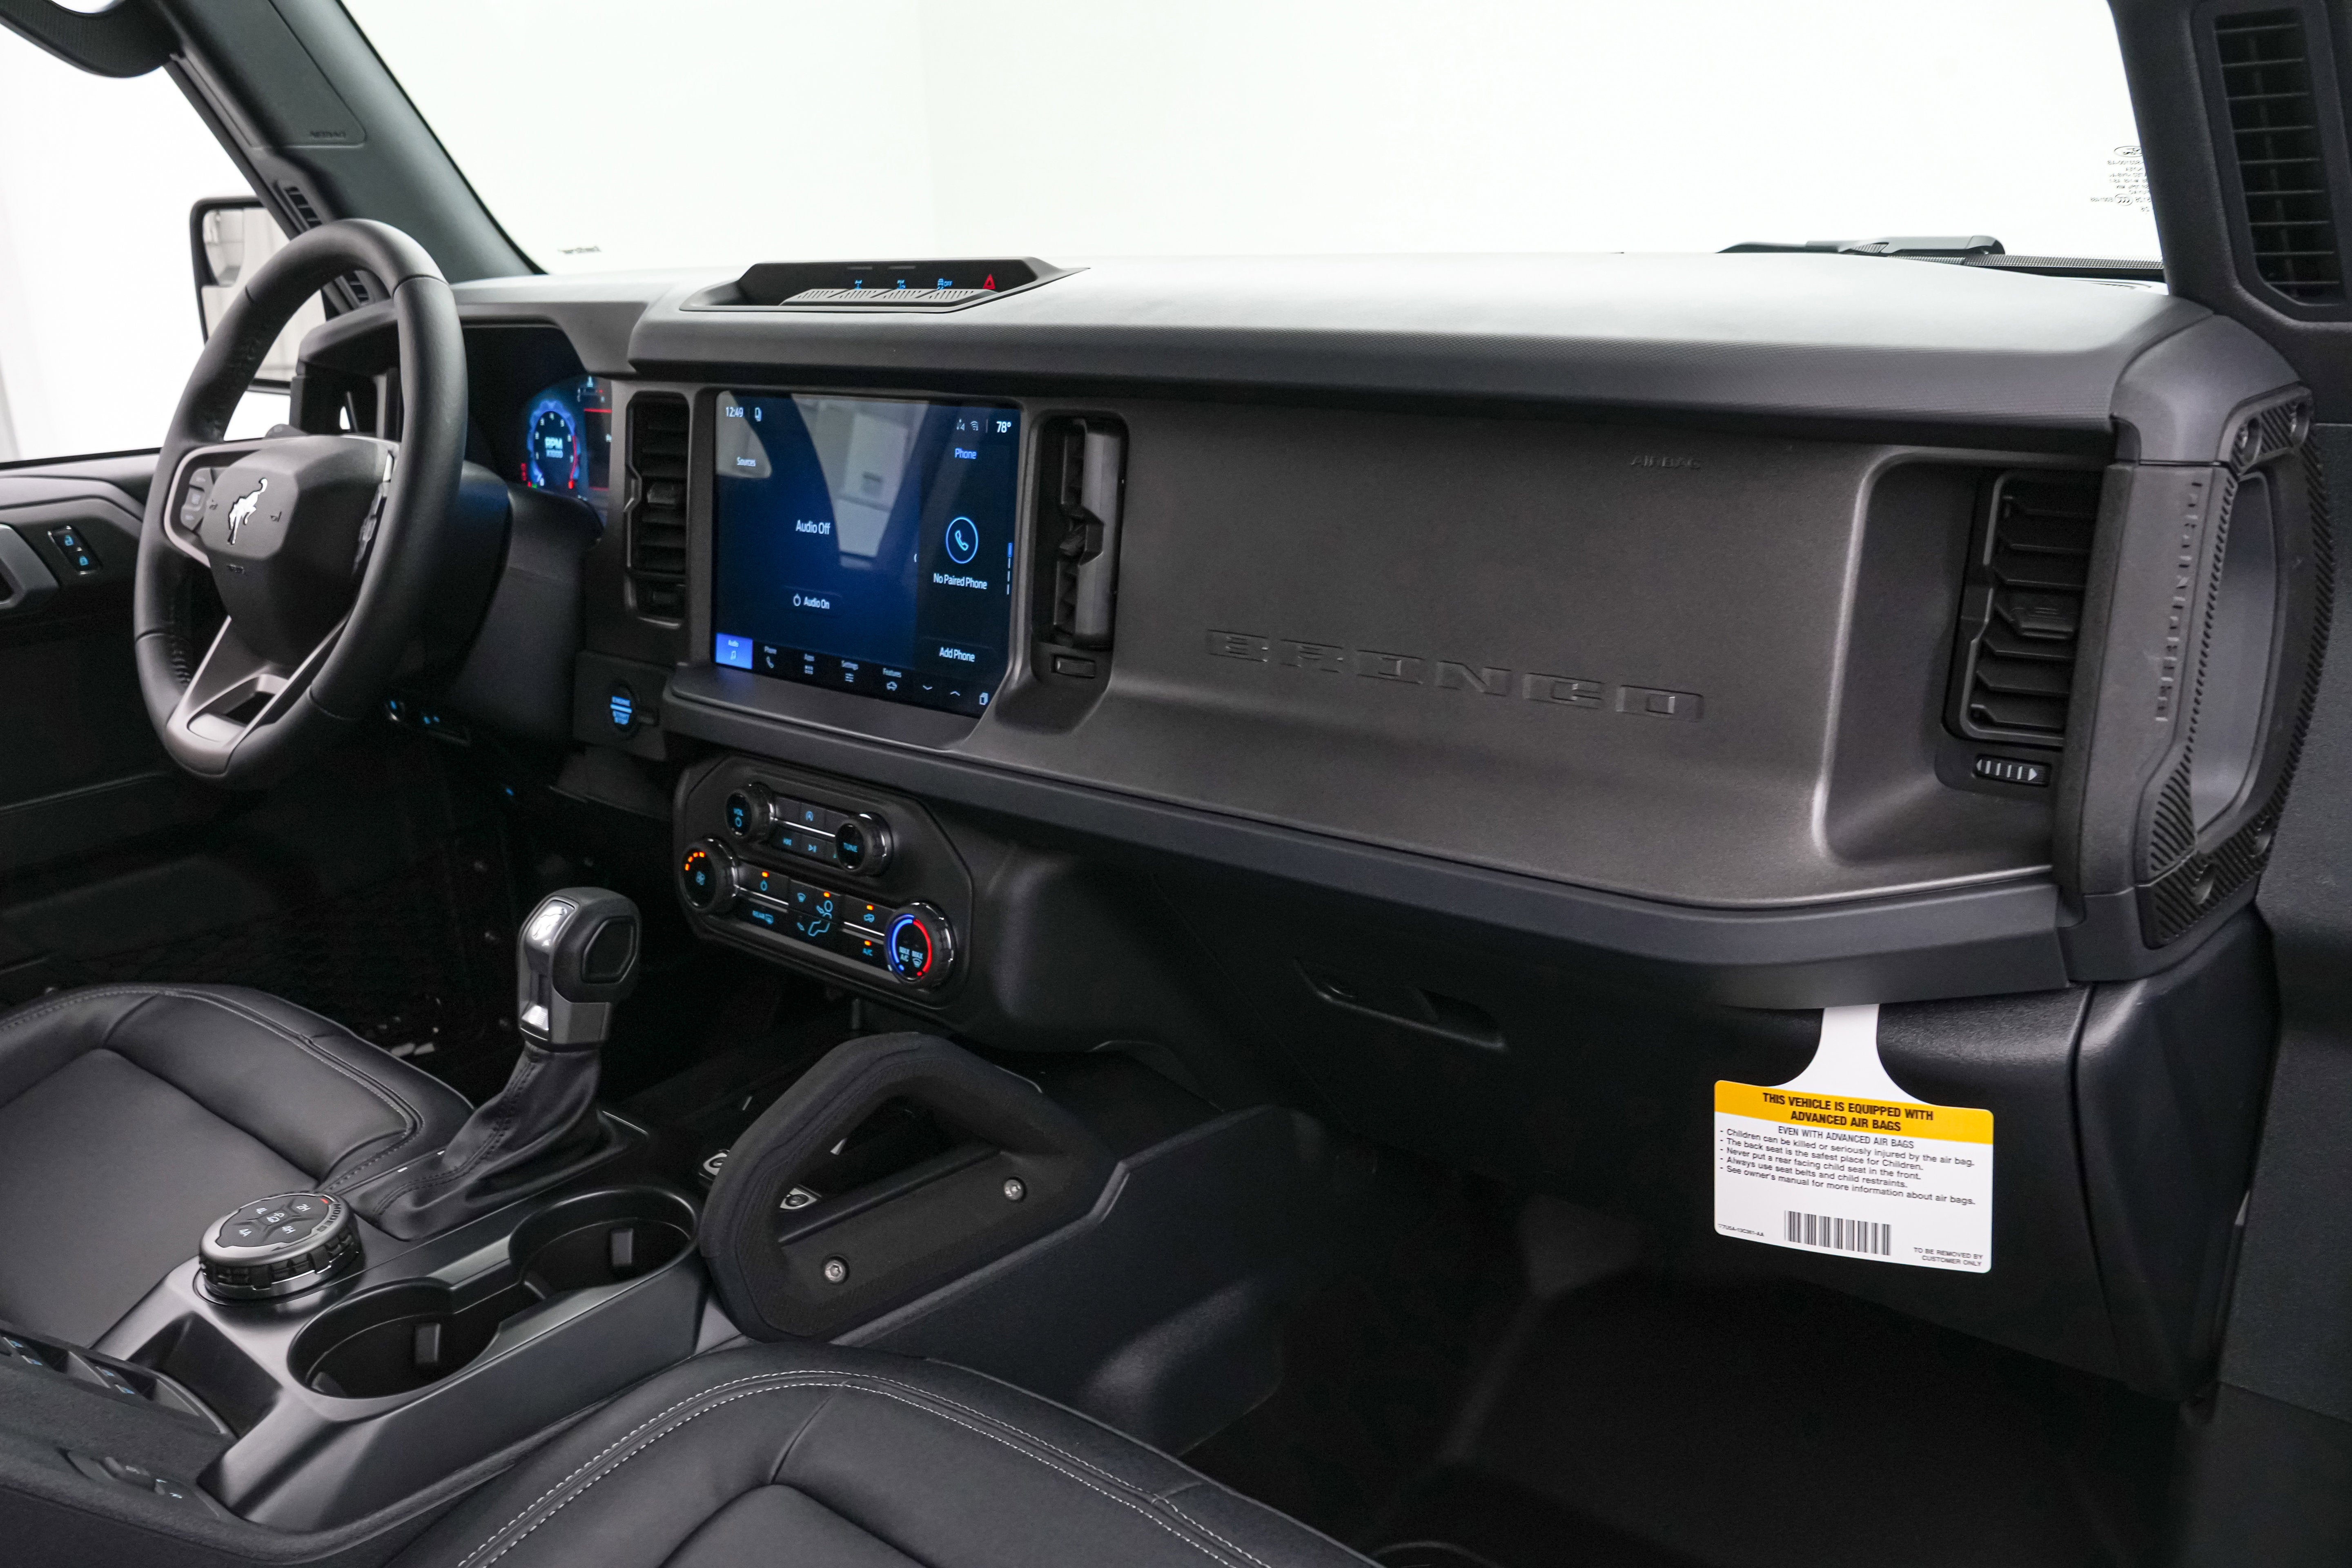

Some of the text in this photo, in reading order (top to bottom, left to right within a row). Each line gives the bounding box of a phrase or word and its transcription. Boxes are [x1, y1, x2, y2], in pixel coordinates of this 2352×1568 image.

[726, 407, 744, 417] 12:49
[996, 421, 1011, 433] 78°
[955, 447, 977, 459] Phone
[795, 519, 831, 535] Audio Off
[933, 572, 988, 589] No Paired Phone
[803, 596, 830, 609] Audio On
[939, 646, 976, 662] Add Phone
[1205, 628, 1704, 722] BRONCO
[1763, 1092, 1933, 1120] THIS VEHICLE IS EQUIPPED WITH
[1791, 1111, 1901, 1131] ADVANCED AIR BAGS
[1779, 1126, 1914, 1149] EVEN WITH ADVANCED AIR BAGS
[1726, 1138, 1742, 1147] The
[1744, 1141, 1763, 1150] back
[1766, 1145, 1783, 1154] seat
[1786, 1147, 1792, 1155] is
[1795, 1149, 1809, 1157] the
[1811, 1152, 1837, 1161] safest
[1841, 1155, 1864, 1165] place
[1882, 1159, 1923, 1170] Children.
[1727, 1128, 1761, 1140] Children
[1793, 1140, 1816, 1149] killed
[1831, 1145, 1872, 1155] seriously
[1875, 1149, 1906, 1159] injured
[1909, 1153, 1920, 1161] by
[1955, 1157, 1974, 1167] bag.
[1727, 1147, 1750, 1157] Never
[1753, 1152, 1766, 1160] put
[1775, 1156, 1792, 1164] rear
[1794, 1158, 1820, 1169] facing
[1824, 1162, 1844, 1171] child
[1897, 1170, 1921, 1180] front.
[1727, 1156, 1755, 1167] Always
[1775, 1165, 1792, 1174] seat
[1795, 1168, 1816, 1177] belts
[1819, 1171, 1835, 1179] and
[1838, 1174, 1859, 1182] child
[1862, 1177, 1907, 1188] restraints.
[1727, 1165, 1742, 1174] See
[1744, 1170, 1775, 1180] owner's
[1779, 1174, 1809, 1185] manual
[1852, 1185, 1903, 1197] information
[1907, 1191, 1932, 1200] about
[1950, 1196, 1975, 1205] bags.
[282, 1226, 296, 1234] 4H
[1922, 1255, 1960, 1264] CUSTOMER
[1937, 1250, 1970, 1258] REMOVED
